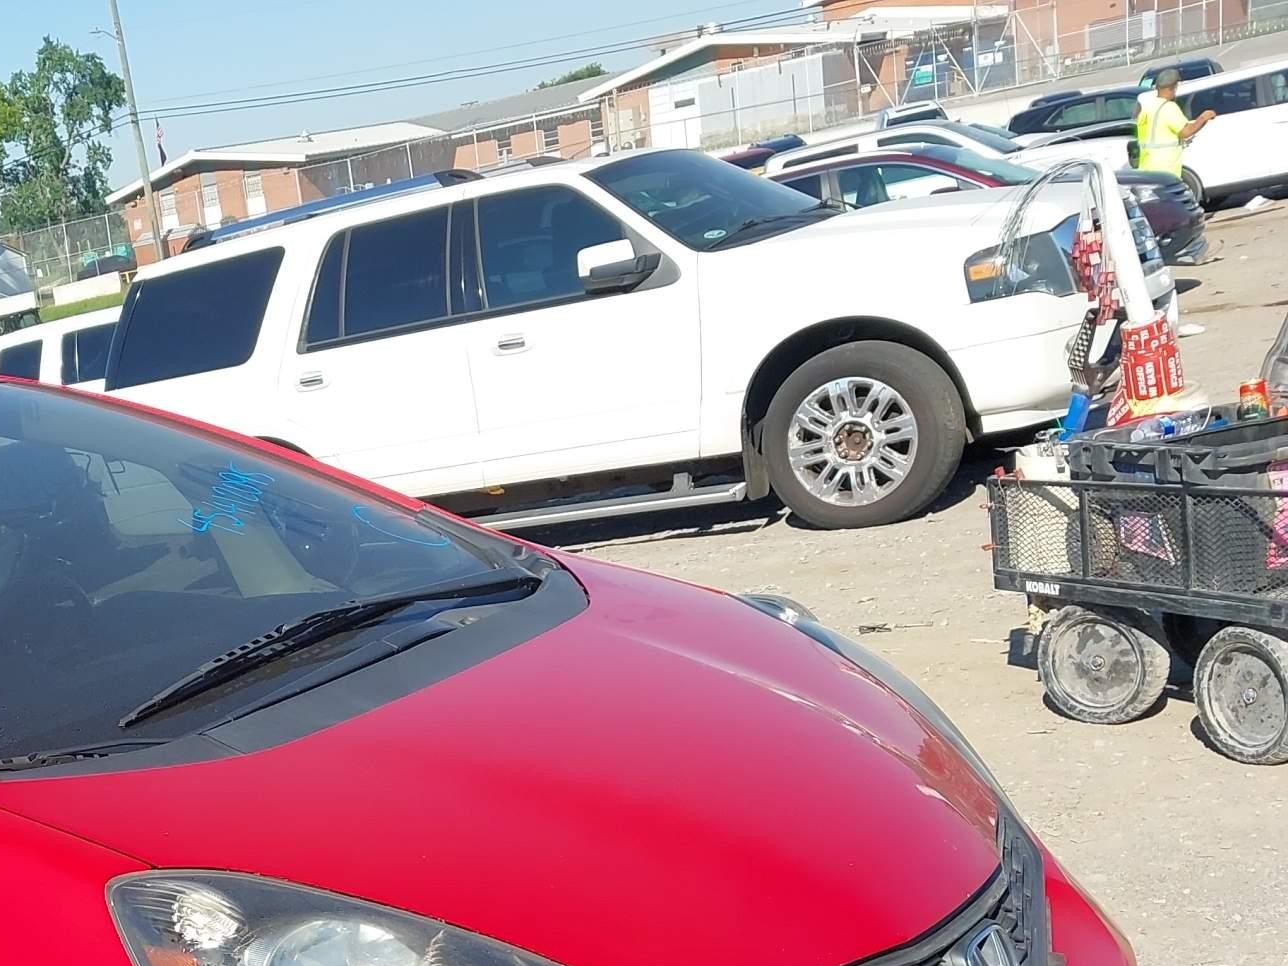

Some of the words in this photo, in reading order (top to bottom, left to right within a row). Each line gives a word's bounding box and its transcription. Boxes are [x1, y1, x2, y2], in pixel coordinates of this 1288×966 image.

[1135, 365, 1147, 395] OFFICE
[1144, 362, 1156, 385] KEYS
[1025, 581, 1060, 595] KOBALT
